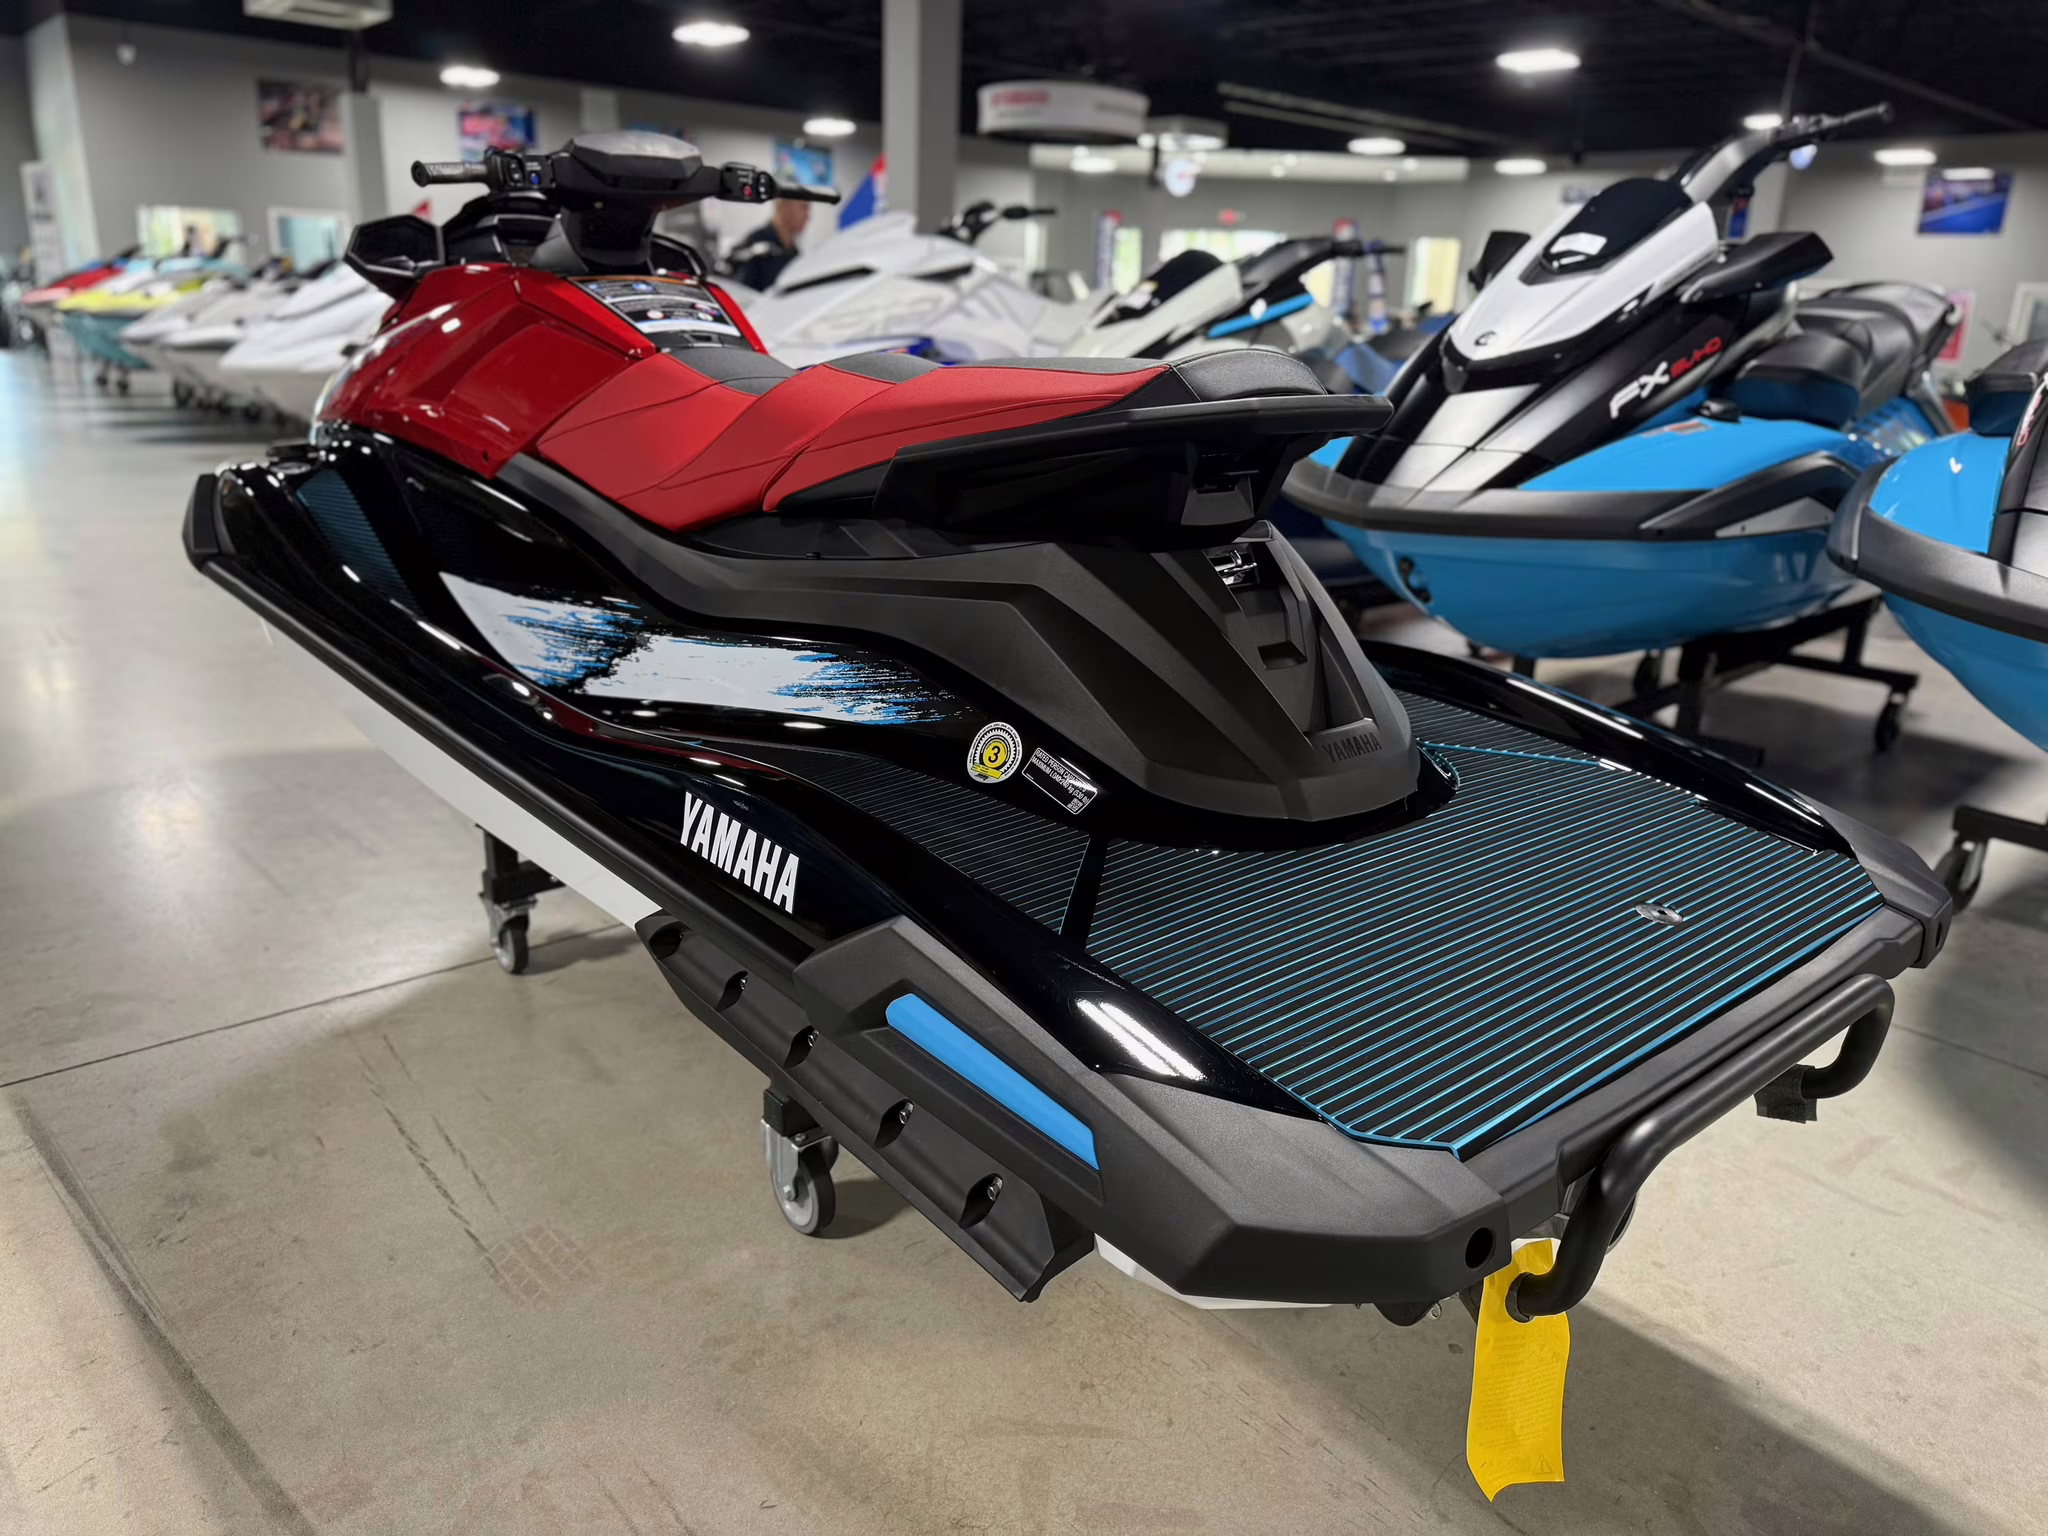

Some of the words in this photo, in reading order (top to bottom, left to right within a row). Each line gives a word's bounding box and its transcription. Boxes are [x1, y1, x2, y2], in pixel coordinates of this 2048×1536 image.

[1609, 361, 1670, 419] FX
[988, 745, 1001, 763] 3
[1321, 732, 1382, 762] YAMAHA
[1031, 756, 1052, 775] MAXIMUM
[1035, 750, 1049, 763] RATED
[1047, 759, 1066, 775] PERSON
[680, 791, 800, 914] YAMAHA
